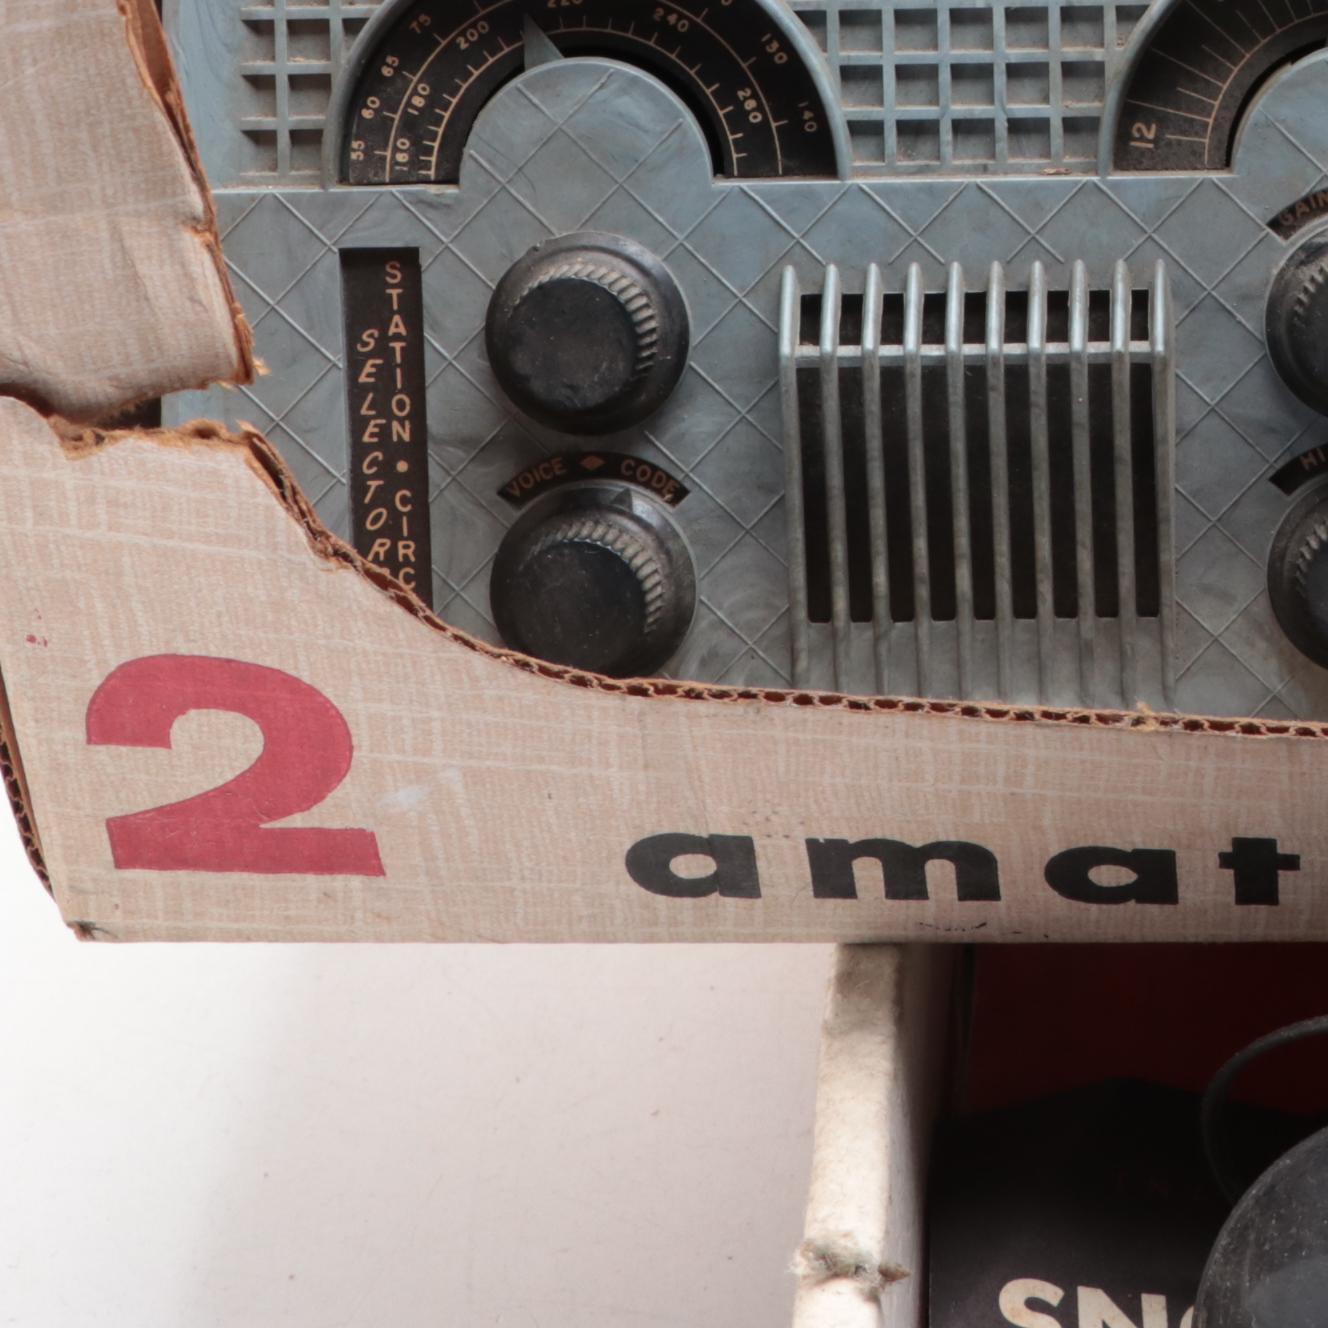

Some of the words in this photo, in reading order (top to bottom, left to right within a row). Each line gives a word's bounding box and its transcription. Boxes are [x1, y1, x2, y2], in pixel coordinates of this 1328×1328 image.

[351, 140, 366, 161] 55
[361, 96, 381, 119] 60
[381, 55, 400, 77] 65
[410, 14, 432, 34] 75
[761, 33, 788, 64] 130
[798, 102, 817, 132] 140
[394, 138, 411, 170] 160
[407, 83, 431, 115] 180
[456, 21, 489, 50] 200
[652, 7, 689, 32] 240
[1129, 121, 1158, 150] 12
[385, 261, 411, 442] STATION
[357, 329, 391, 575] SELECTOR
[506, 456, 568, 499] VOICE
[620, 458, 680, 502] CODE
[1301, 448, 1326, 471] HI
[85, 653, 386, 877] 2
